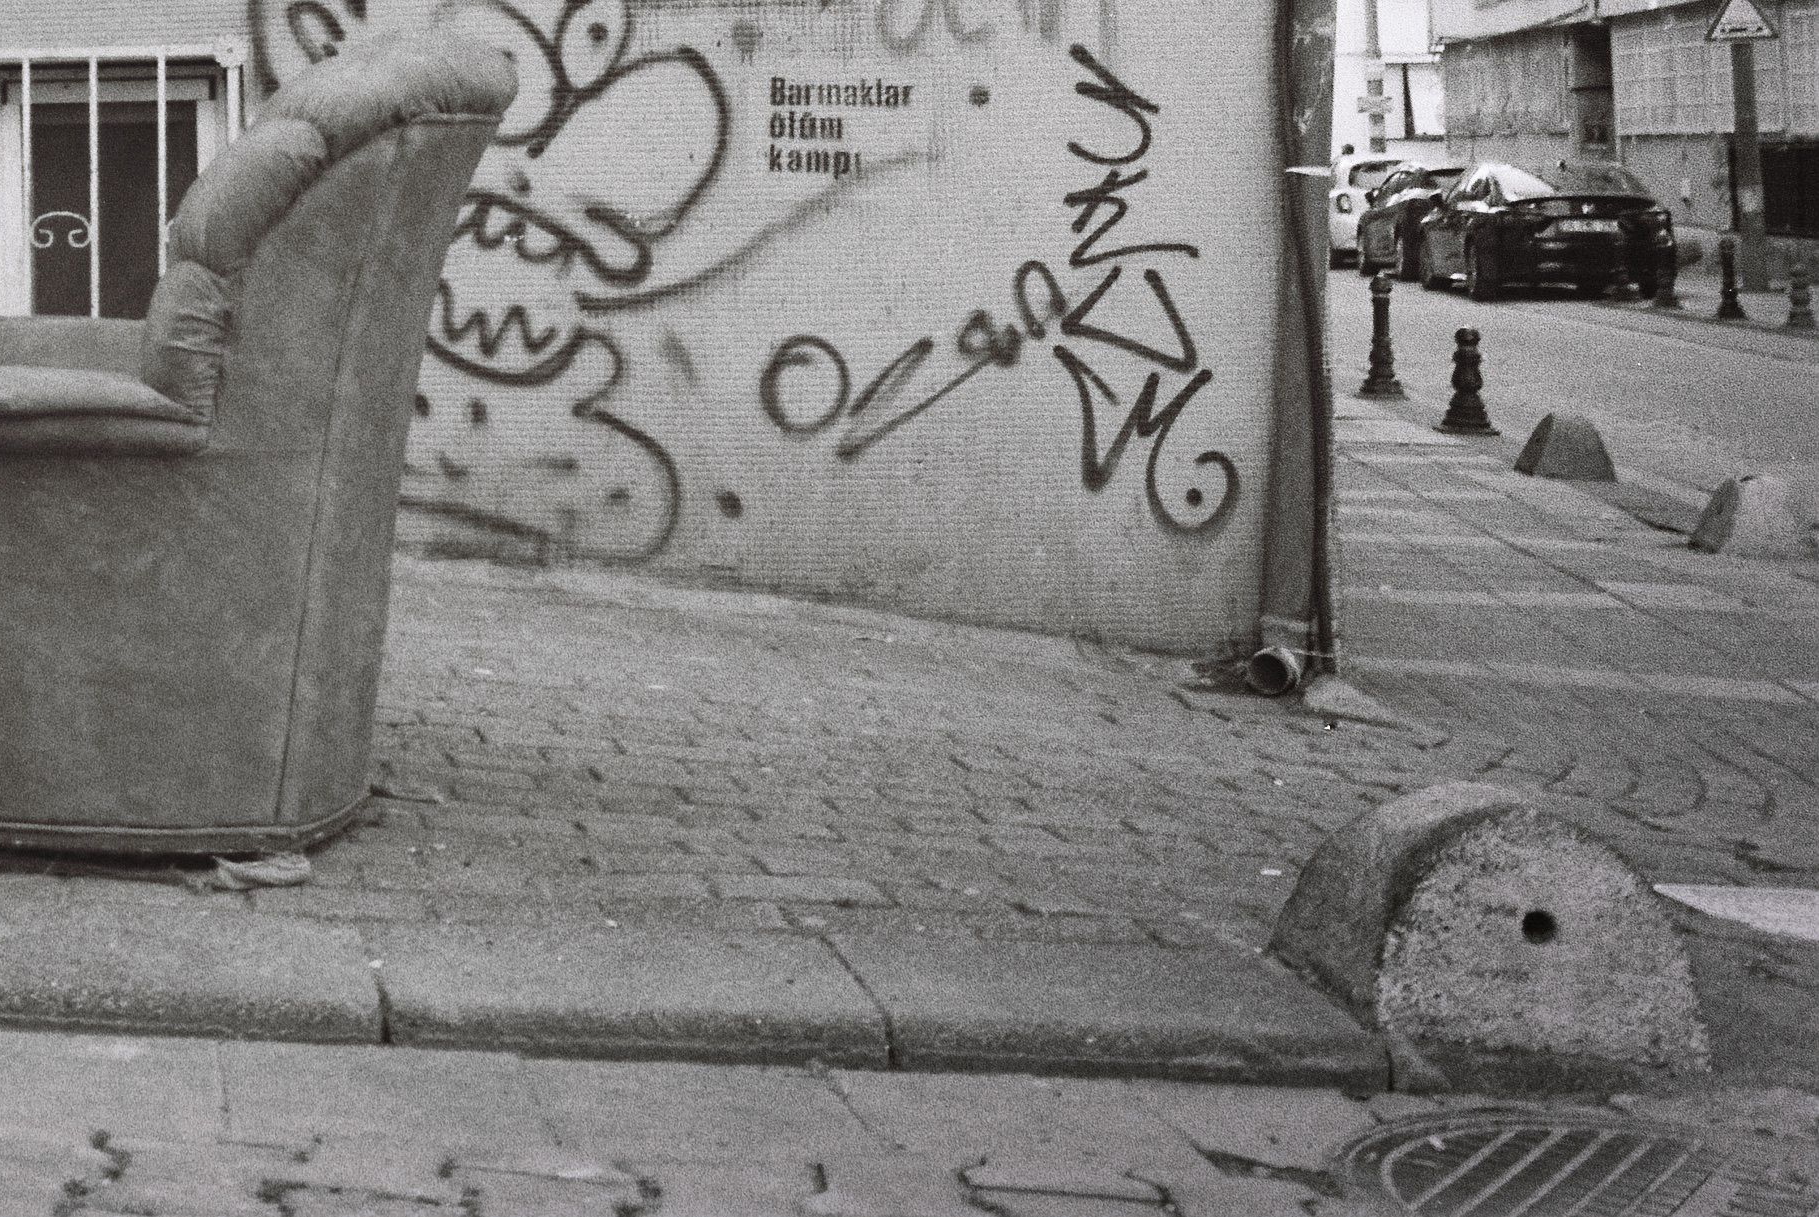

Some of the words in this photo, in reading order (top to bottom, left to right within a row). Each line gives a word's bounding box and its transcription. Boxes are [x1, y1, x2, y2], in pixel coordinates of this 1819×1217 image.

[769, 77, 914, 107] Barınaklar
[769, 110, 844, 141] ölüm
[769, 143, 863, 180] kampı
